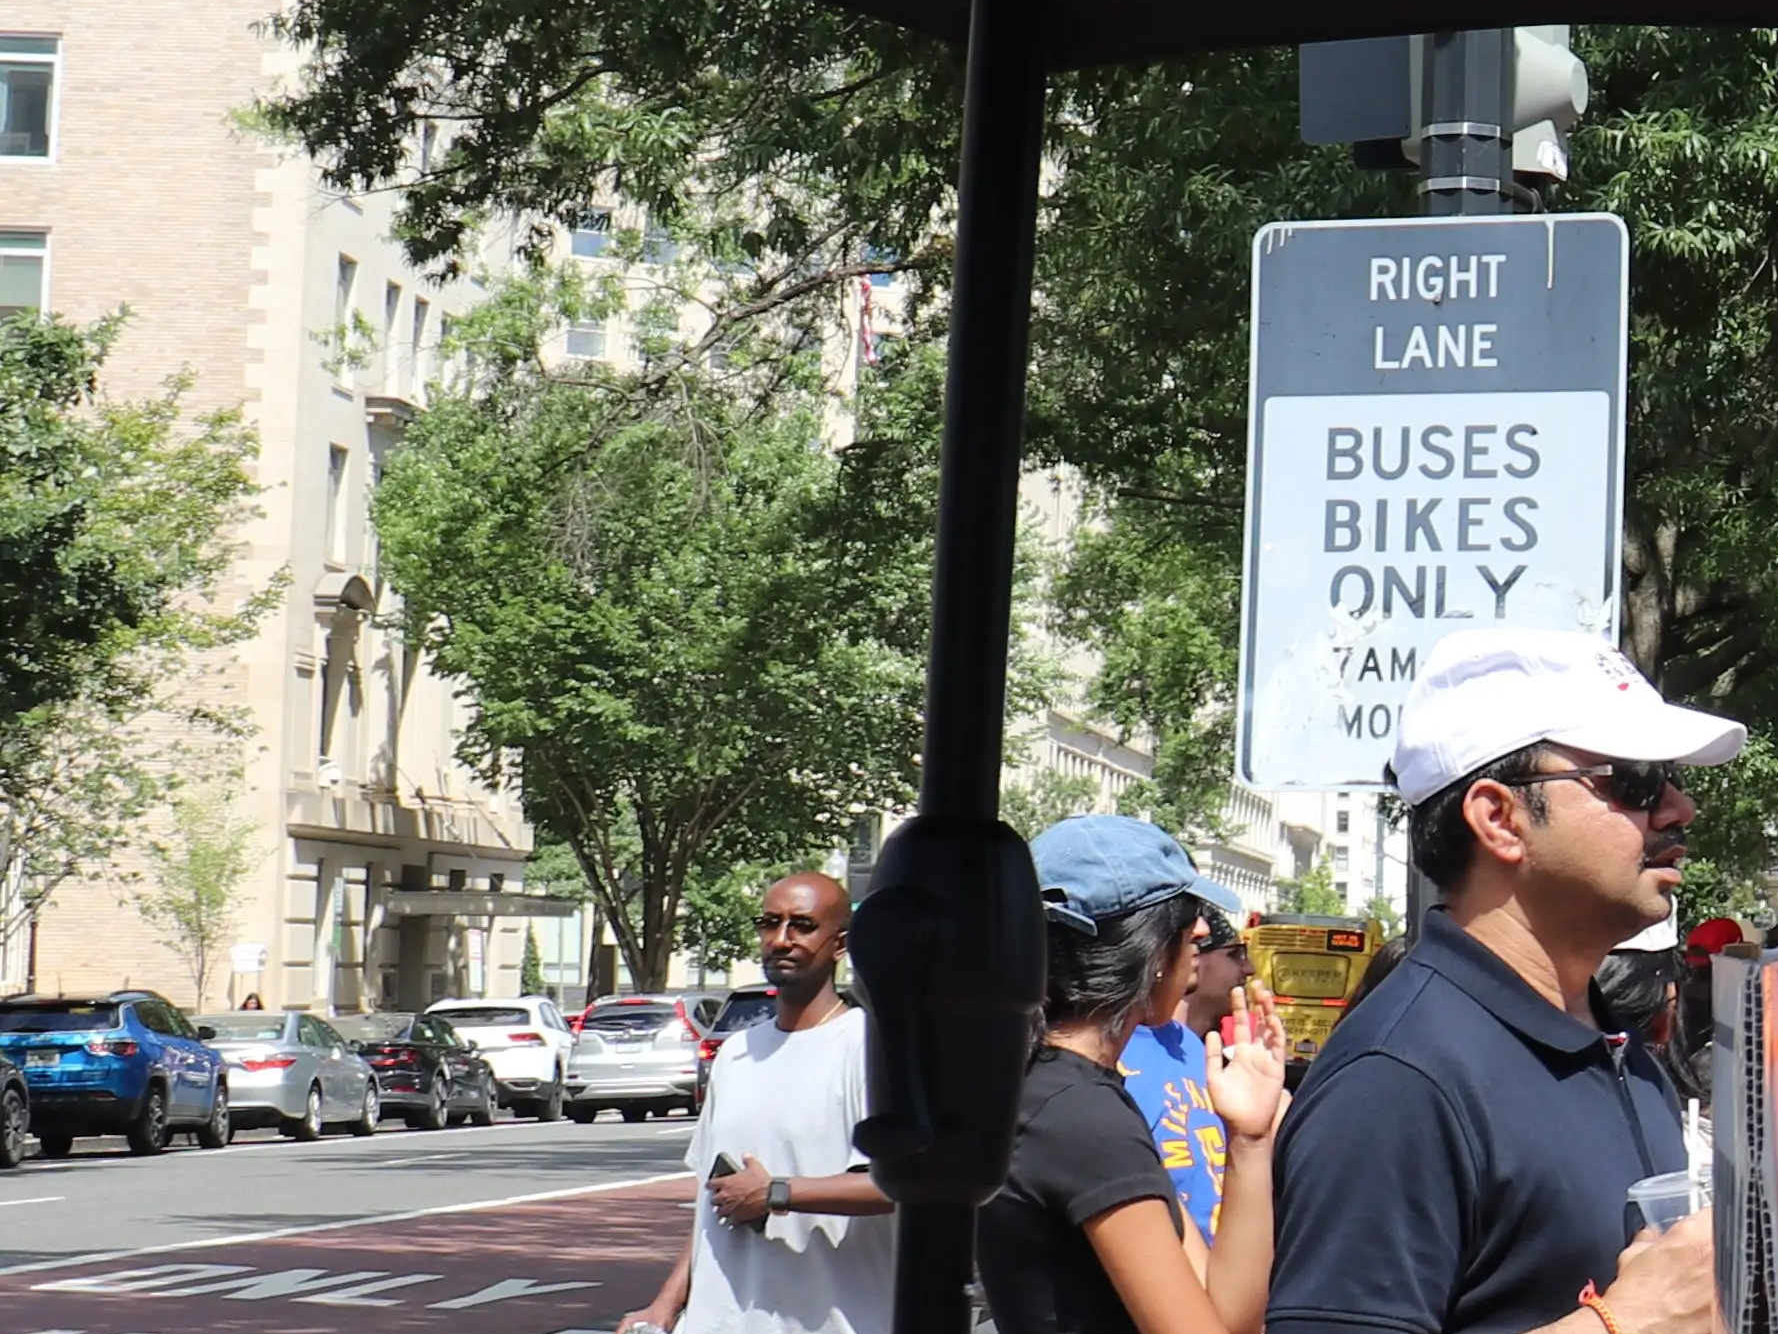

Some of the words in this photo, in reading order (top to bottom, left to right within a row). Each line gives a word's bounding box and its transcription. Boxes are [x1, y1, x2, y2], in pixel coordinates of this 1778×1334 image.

[1369, 254, 1507, 301] RIGHT
[1374, 324, 1498, 369] LANE
[1326, 424, 1541, 480] BUSES
[1323, 496, 1539, 553] BIKES
[1330, 565, 1529, 619] ONLY
[1333, 646, 1424, 682] 7AM
[1337, 704, 1403, 740] MO
[30, 1263, 603, 1309] ONLY
